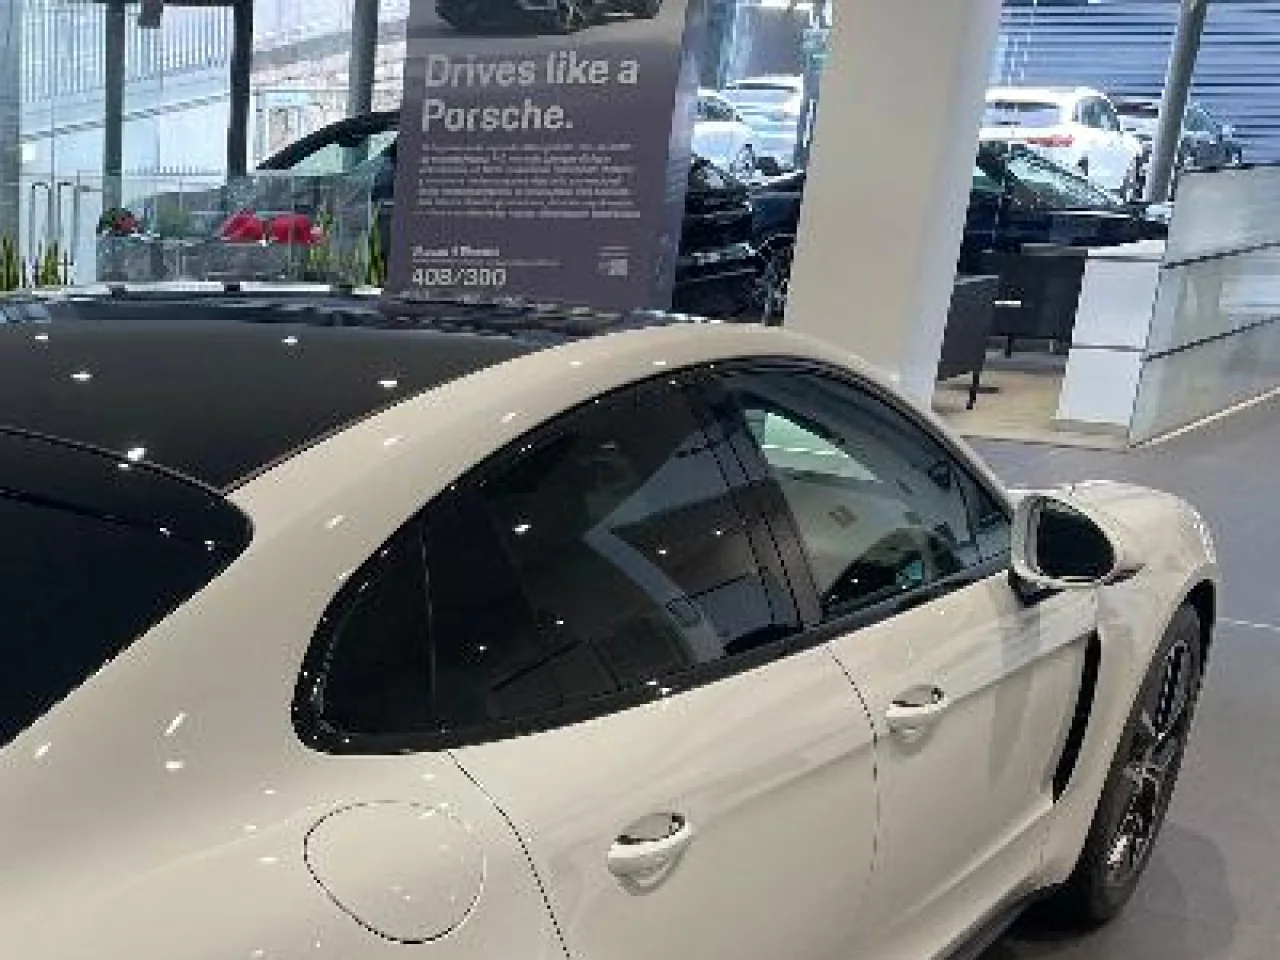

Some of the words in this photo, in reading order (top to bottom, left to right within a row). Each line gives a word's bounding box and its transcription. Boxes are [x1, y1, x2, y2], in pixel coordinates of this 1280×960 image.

[425, 53, 536, 88] Drives
[546, 50, 611, 85] like
[617, 60, 640, 85] a
[421, 98, 575, 132] Porsche.
